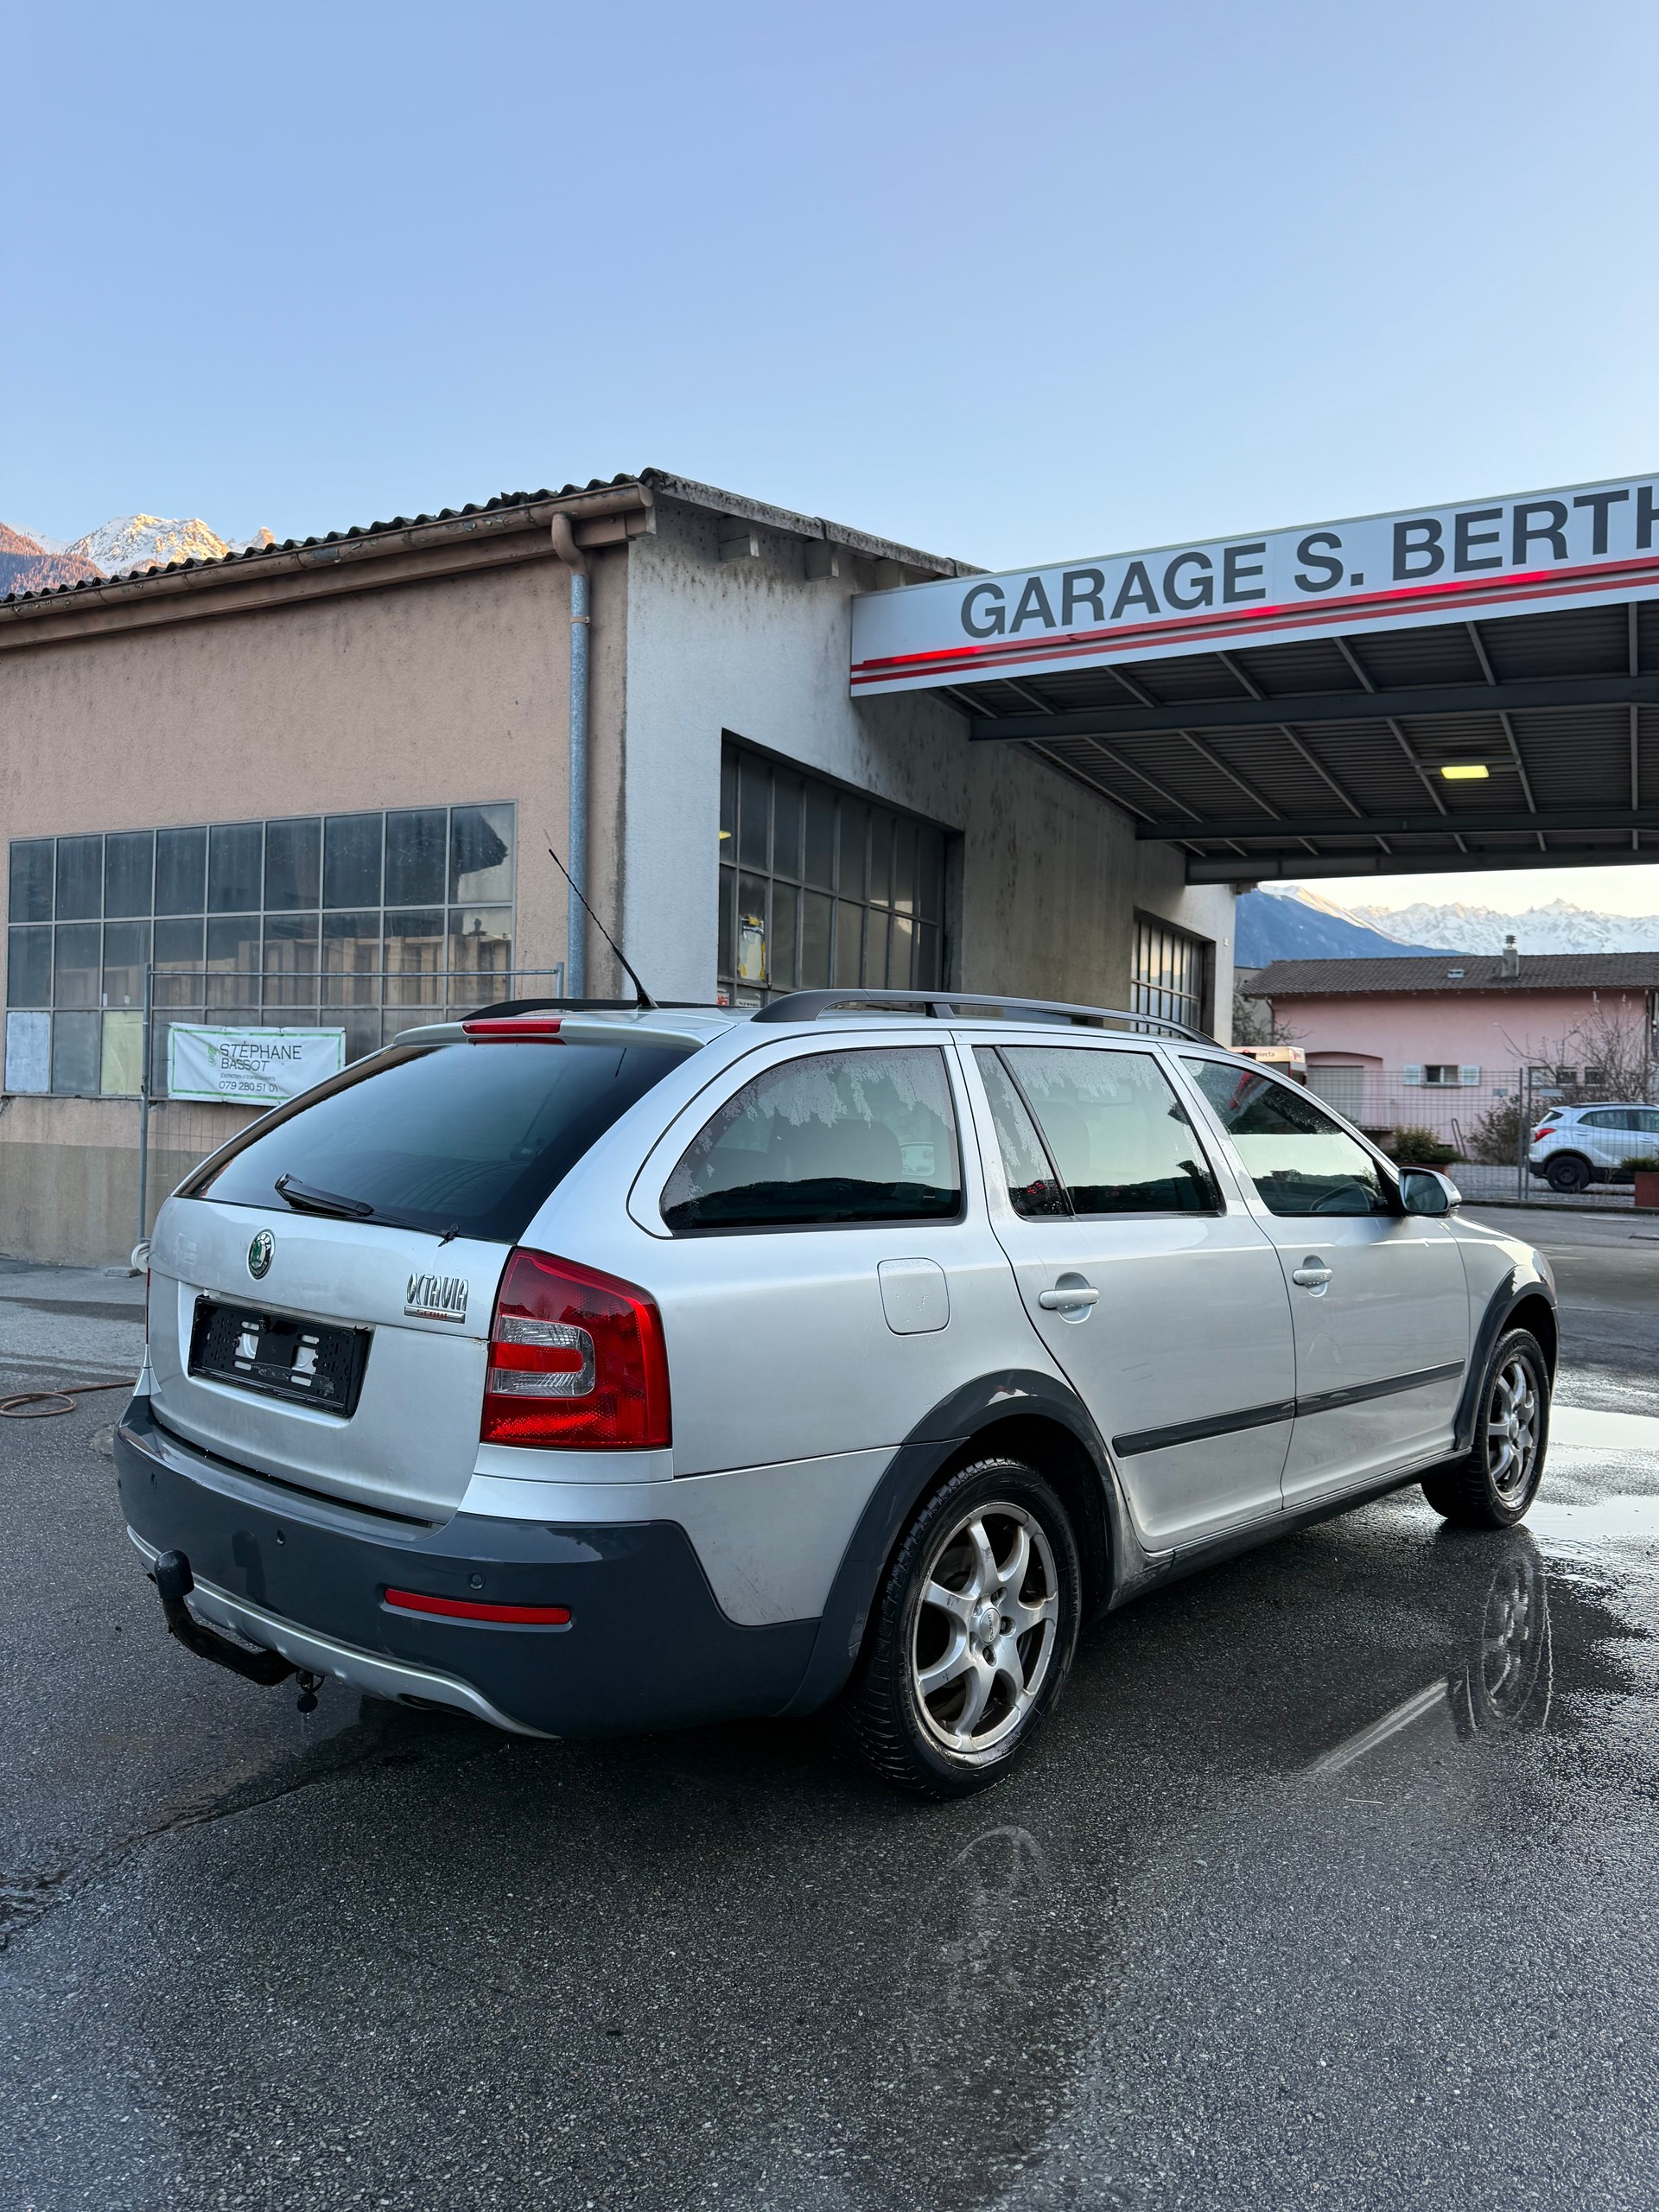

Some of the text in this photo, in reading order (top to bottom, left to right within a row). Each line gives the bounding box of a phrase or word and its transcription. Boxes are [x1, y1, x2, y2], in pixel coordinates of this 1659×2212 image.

[960, 542, 1267, 639] GARAGE
[1294, 531, 1364, 593] S.
[219, 1040, 302, 1059] STÉPHANE
[221, 1058, 270, 1071] BASSOT
[219, 1081, 237, 1090] 079
[238, 1082, 255, 1090] 280
[257, 1083, 266, 1091] 51
[407, 1272, 469, 1312] OCTAVIA
